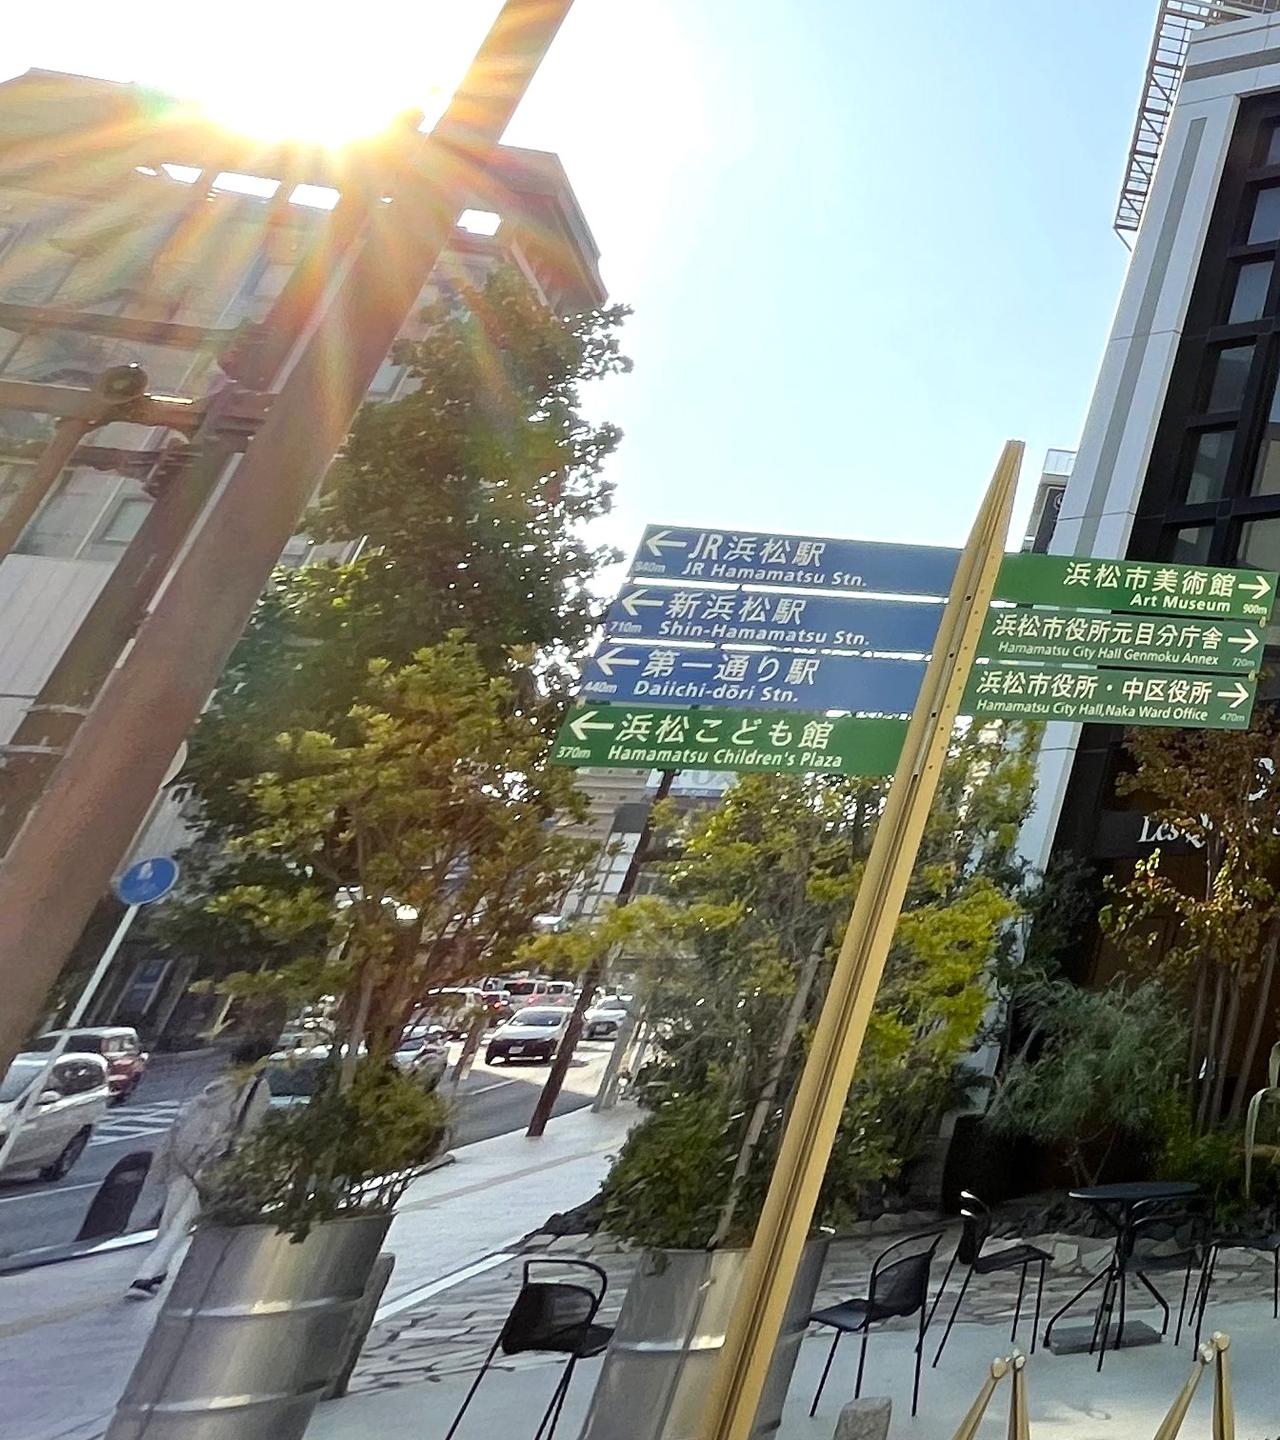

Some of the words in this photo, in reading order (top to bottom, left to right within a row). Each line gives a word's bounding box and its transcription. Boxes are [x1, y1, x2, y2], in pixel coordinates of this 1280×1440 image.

[688, 532, 826, 567] JR浜松駅
[682, 562, 705, 576] JR
[710, 564, 826, 584] Hamamatsu
[832, 571, 868, 587] Stn.
[1063, 561, 1237, 598] 浜松市美術館
[665, 591, 806, 625] 新浜松駅
[1130, 593, 1157, 608] Art
[1162, 595, 1231, 612] Museum
[658, 621, 827, 643] Shin-Hamamatsu
[834, 630, 871, 646] Stn.
[992, 613, 1223, 650] 浜松市役所元目分庁舎
[998, 641, 1070, 656] Hamamatsu
[1073, 645, 1095, 660] City
[1098, 646, 1122, 659] Hall
[1123, 648, 1180, 663] Genmoku
[1182, 652, 1219, 665] Annex
[641, 649, 820, 685] 第一通り駅
[633, 680, 755, 700] Daiichi-dōri
[760, 686, 799, 703] Stn.
[975, 670, 1213, 705] 浜松市役所・中区役所
[976, 699, 1050, 714] Hamamatsu
[1052, 702, 1075, 717] City
[1139, 705, 1171, 720] Ward
[1172, 708, 1208, 722] Office
[615, 712, 834, 750] 浜松こども館
[556, 745, 591, 759] 370m
[608, 745, 709, 764] Hamamatsu
[713, 748, 795, 767] Children's
[800, 750, 843, 768] Plaza
